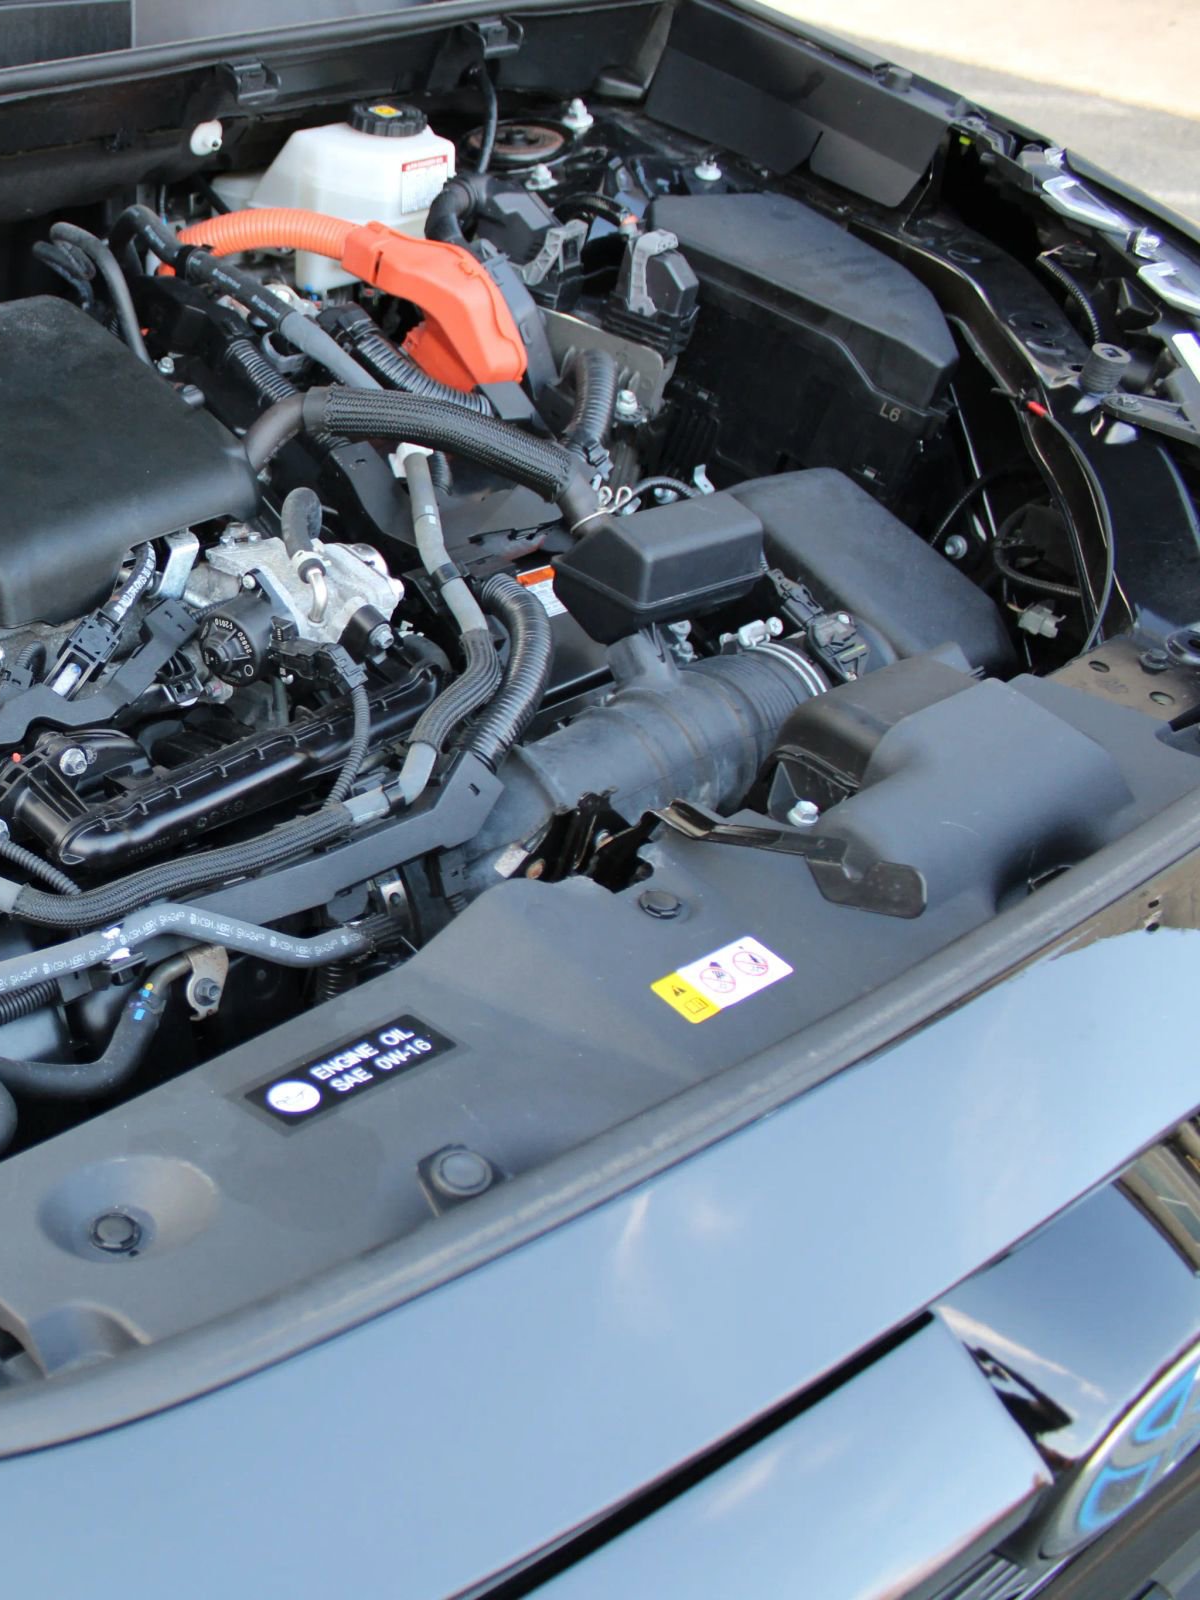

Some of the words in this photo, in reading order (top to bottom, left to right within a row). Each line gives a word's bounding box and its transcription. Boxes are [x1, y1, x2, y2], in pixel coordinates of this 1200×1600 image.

[880, 401, 901, 422] L6
[309, 1041, 380, 1081] ENGINE
[378, 1026, 416, 1047] OIL
[329, 1066, 374, 1092] SAE
[373, 1037, 432, 1071] 0W-16
